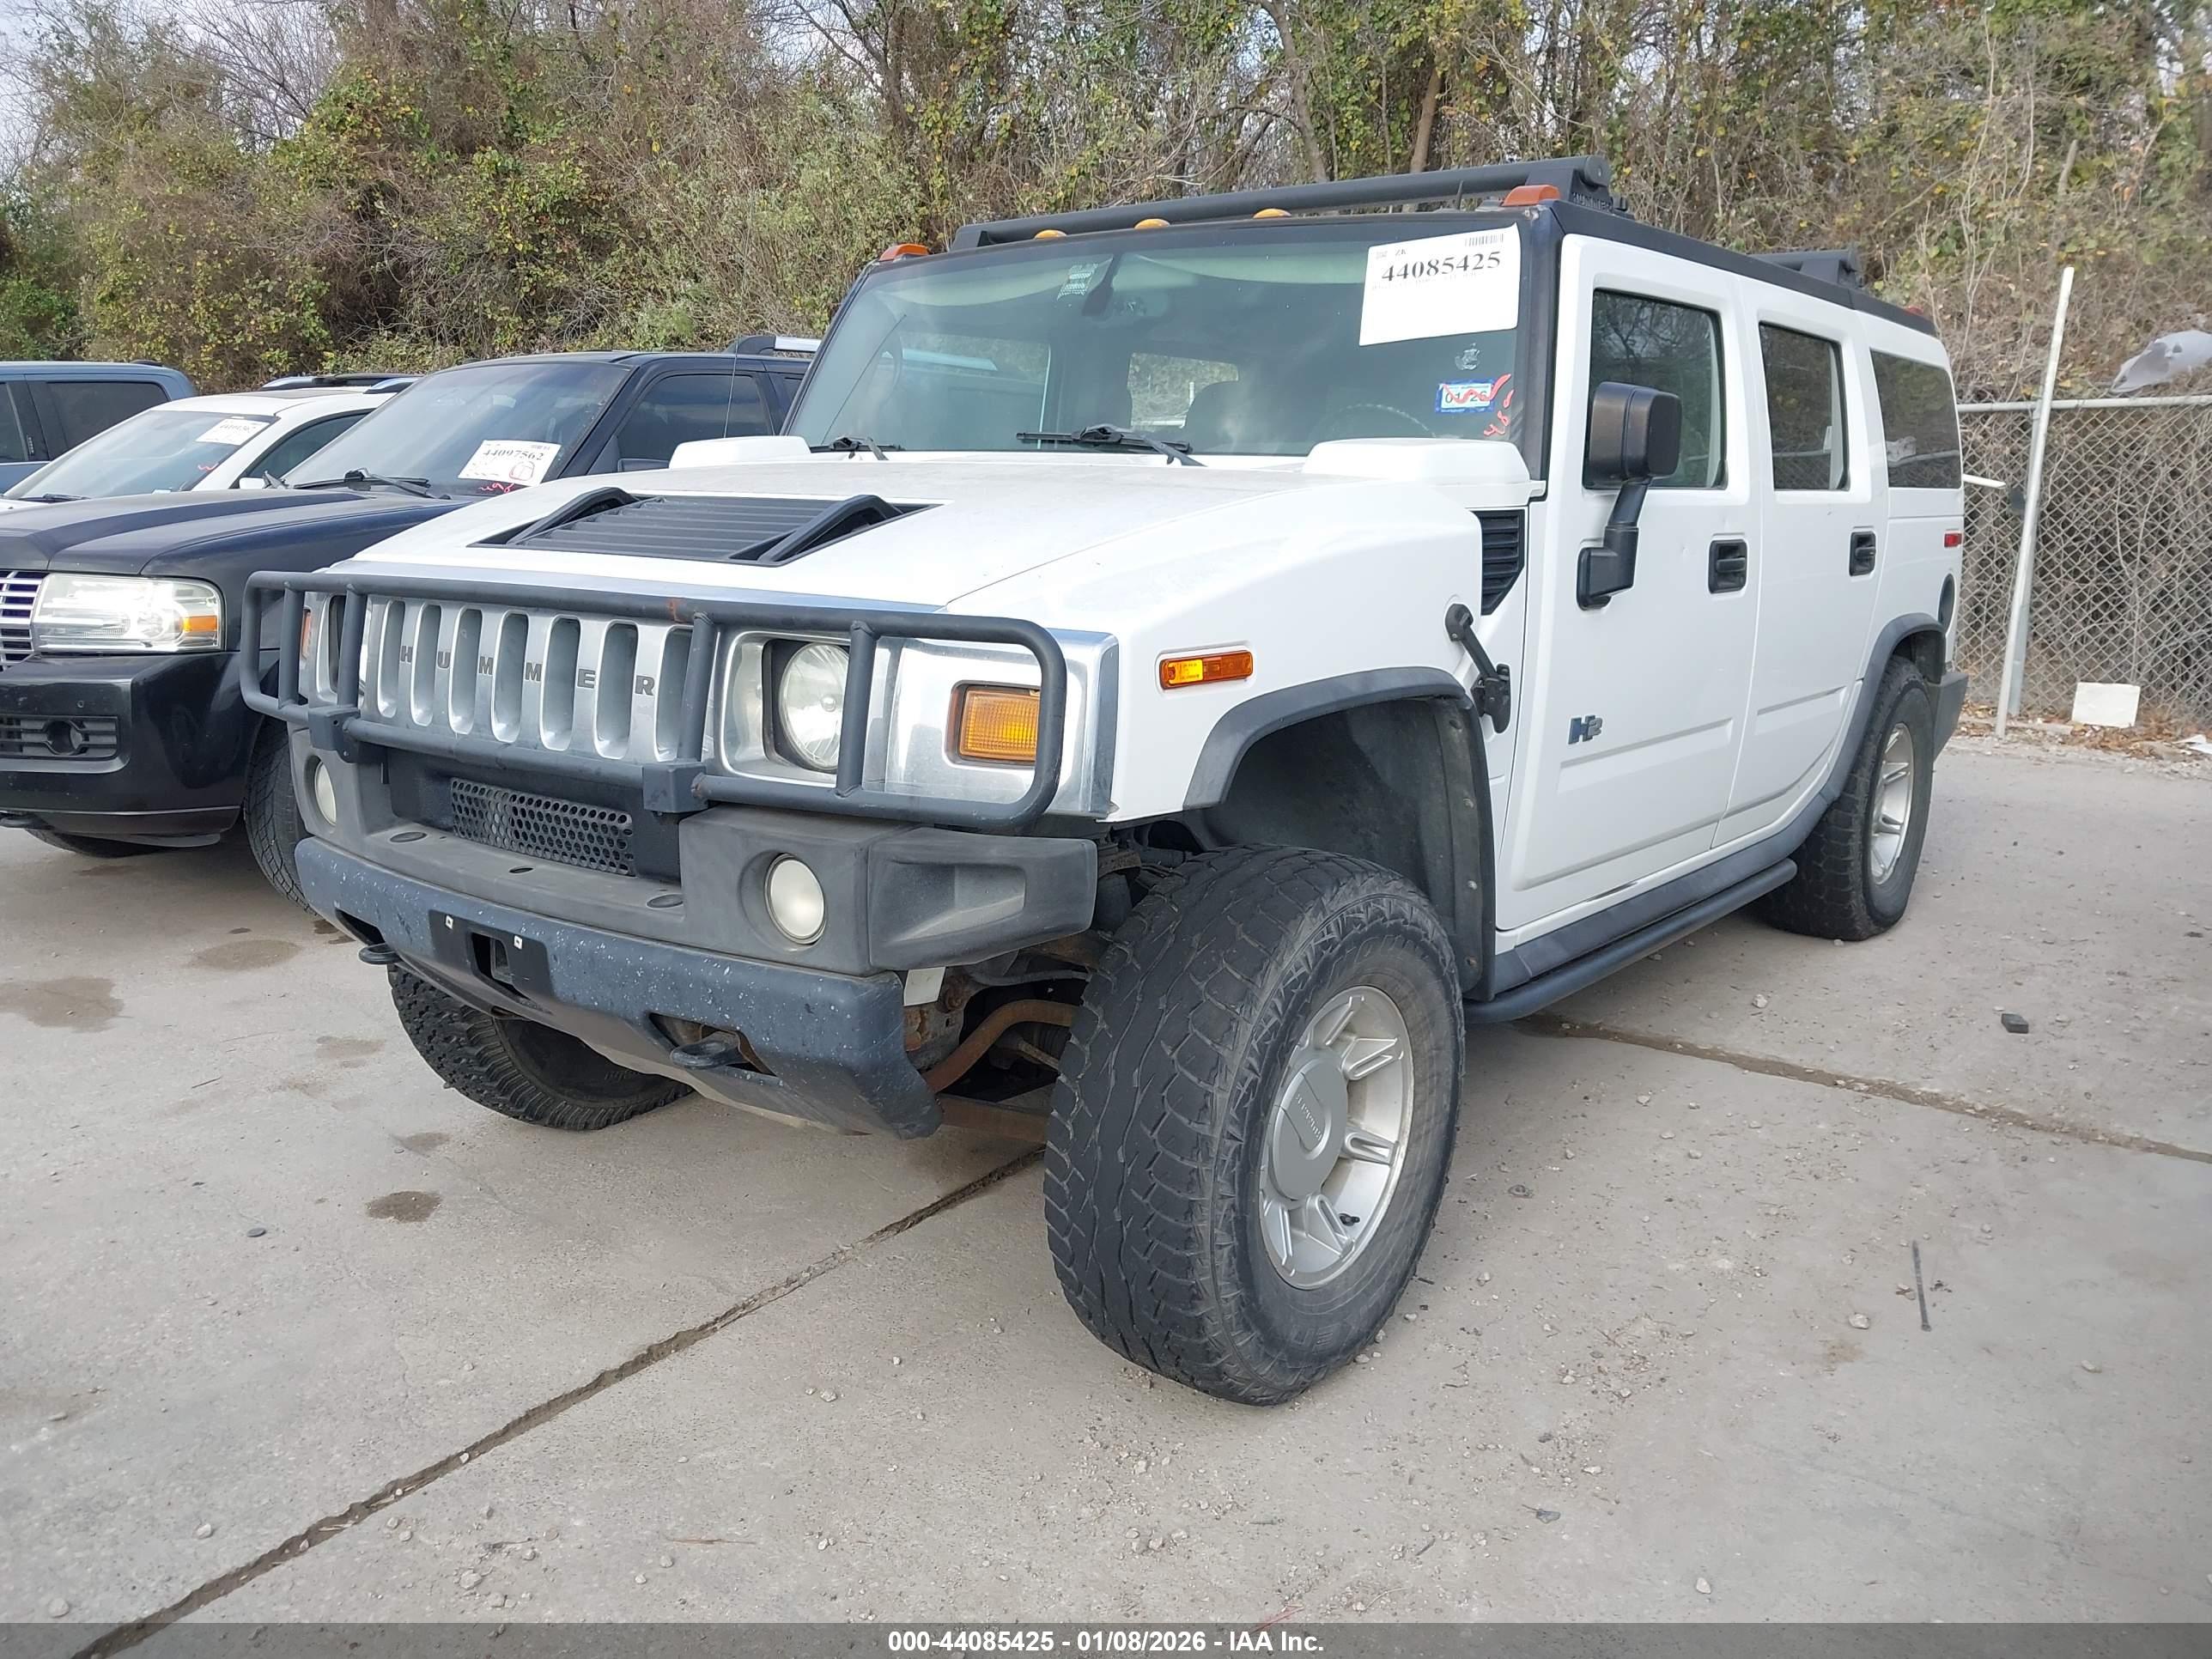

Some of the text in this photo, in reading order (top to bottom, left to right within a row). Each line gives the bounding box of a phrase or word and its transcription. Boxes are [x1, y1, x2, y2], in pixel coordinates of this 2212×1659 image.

[1381, 251, 1502, 282] 44085425
[483, 449, 544, 461] 44097562
[399, 645, 656, 696] HUMMER
[1568, 714, 1603, 745] H2
